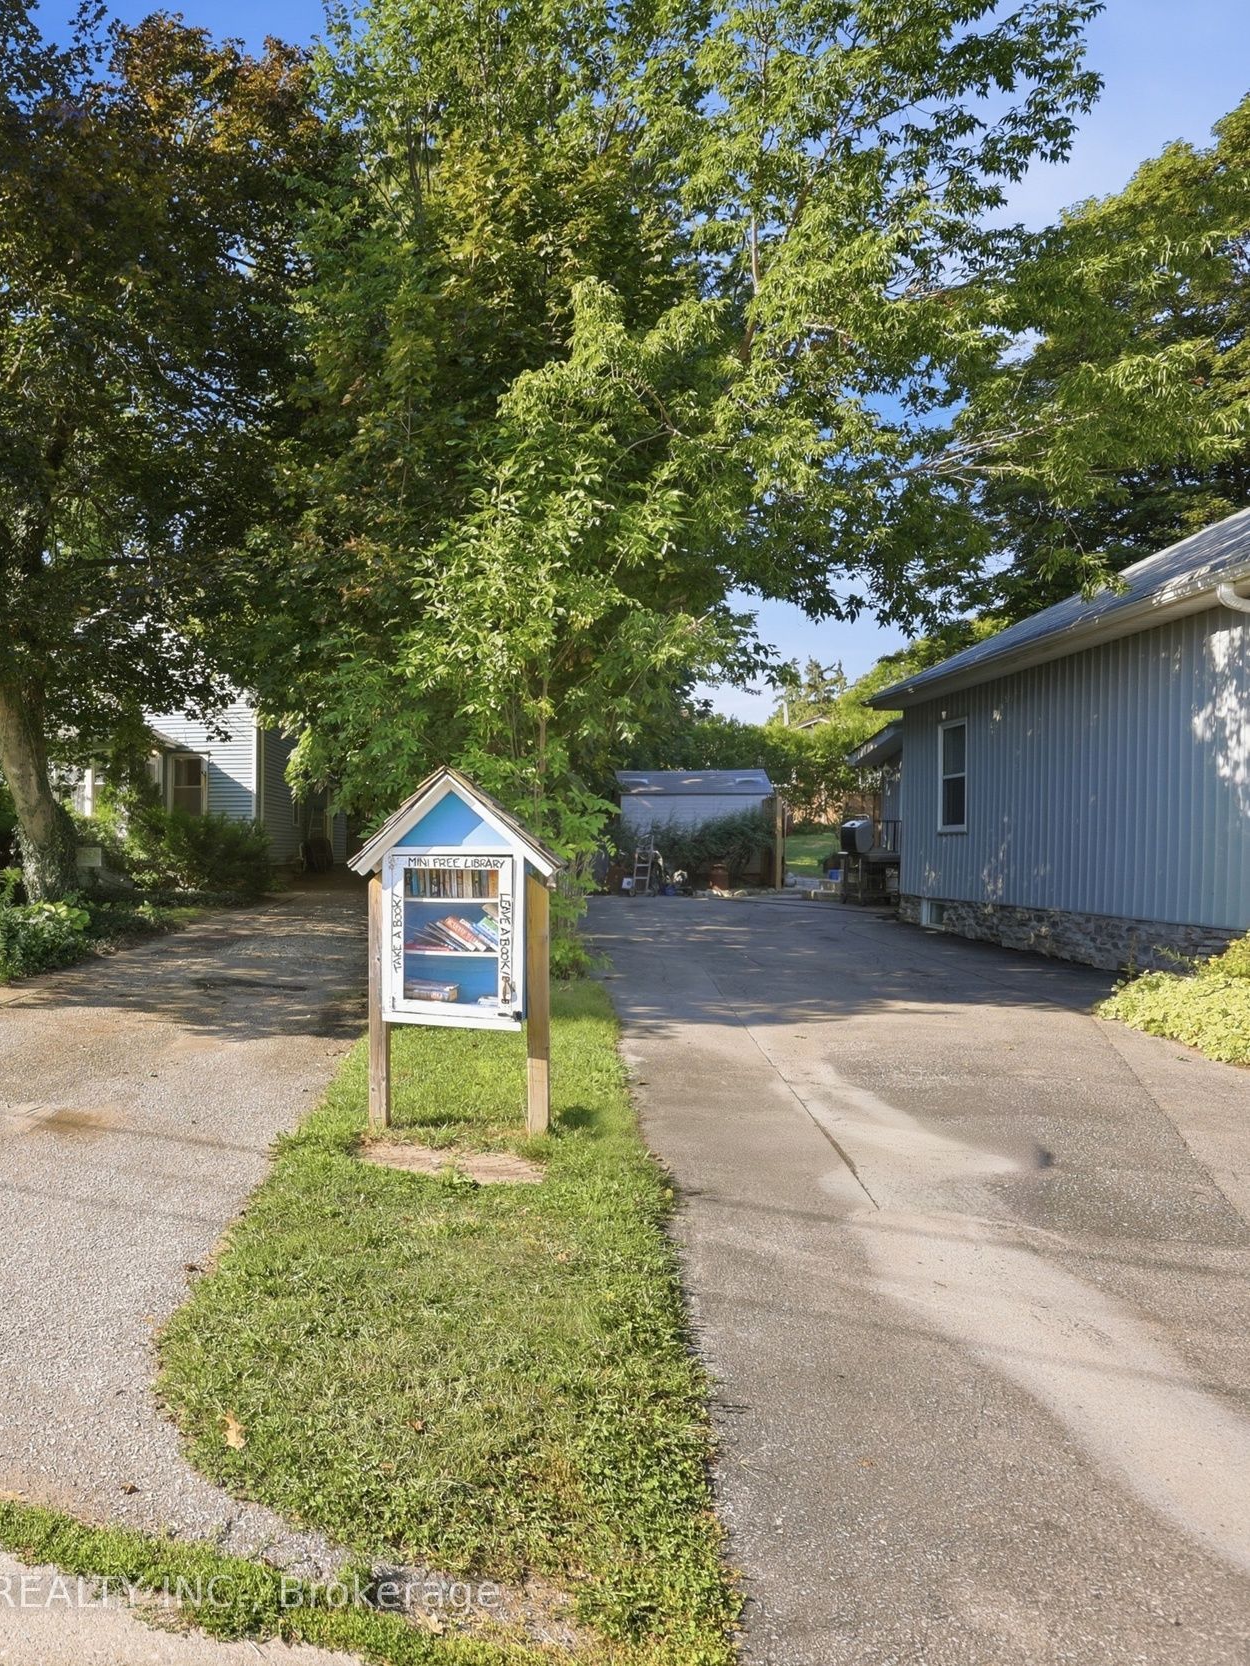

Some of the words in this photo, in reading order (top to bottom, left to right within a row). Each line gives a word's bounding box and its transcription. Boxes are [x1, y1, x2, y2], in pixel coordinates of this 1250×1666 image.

[408, 857, 430, 867] MINI
[433, 857, 461, 868] FREE
[464, 858, 505, 869] LIBRARY
[499, 893, 511, 925] LEAVE
[392, 930, 402, 938] A
[500, 928, 511, 936] A
[392, 944, 402, 973] TAKE
